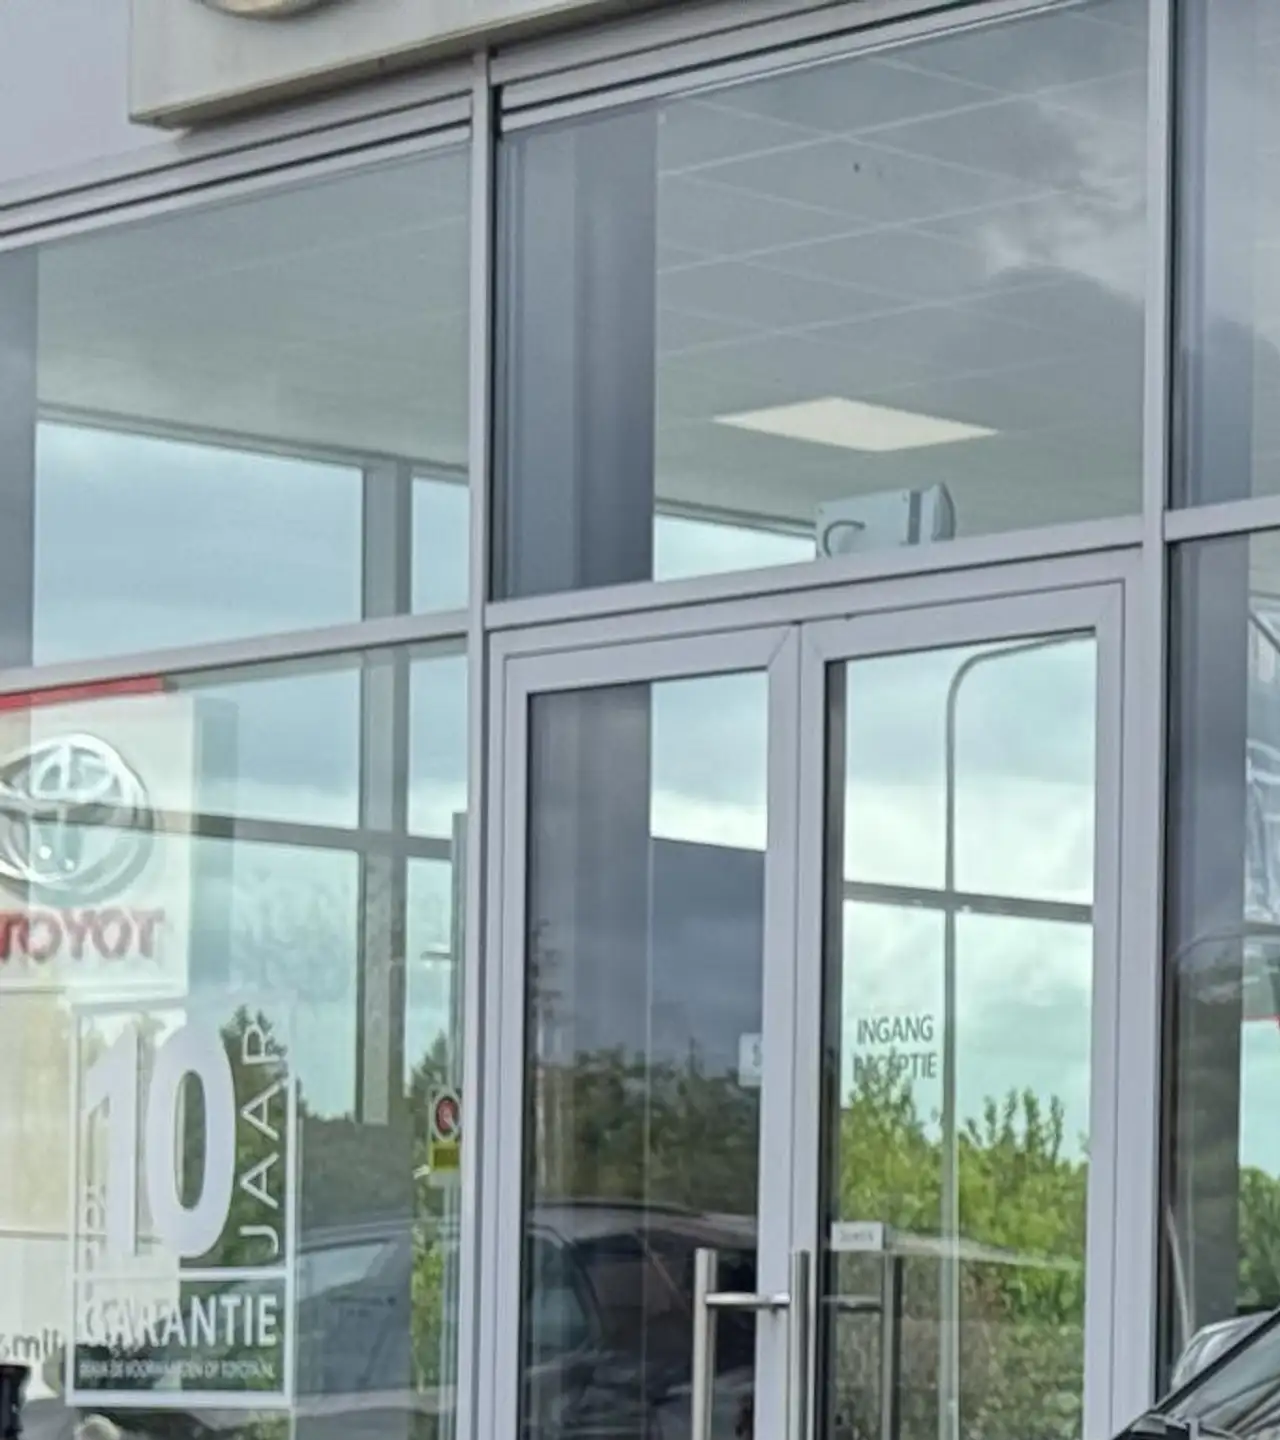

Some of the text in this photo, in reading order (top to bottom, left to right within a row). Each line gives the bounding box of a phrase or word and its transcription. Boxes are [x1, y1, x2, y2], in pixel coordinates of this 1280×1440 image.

[857, 1014, 933, 1045] INGANG
[83, 1018, 237, 1259] 10
[240, 1023, 282, 1255] JAAR
[82, 1293, 278, 1348] GARANTIE
